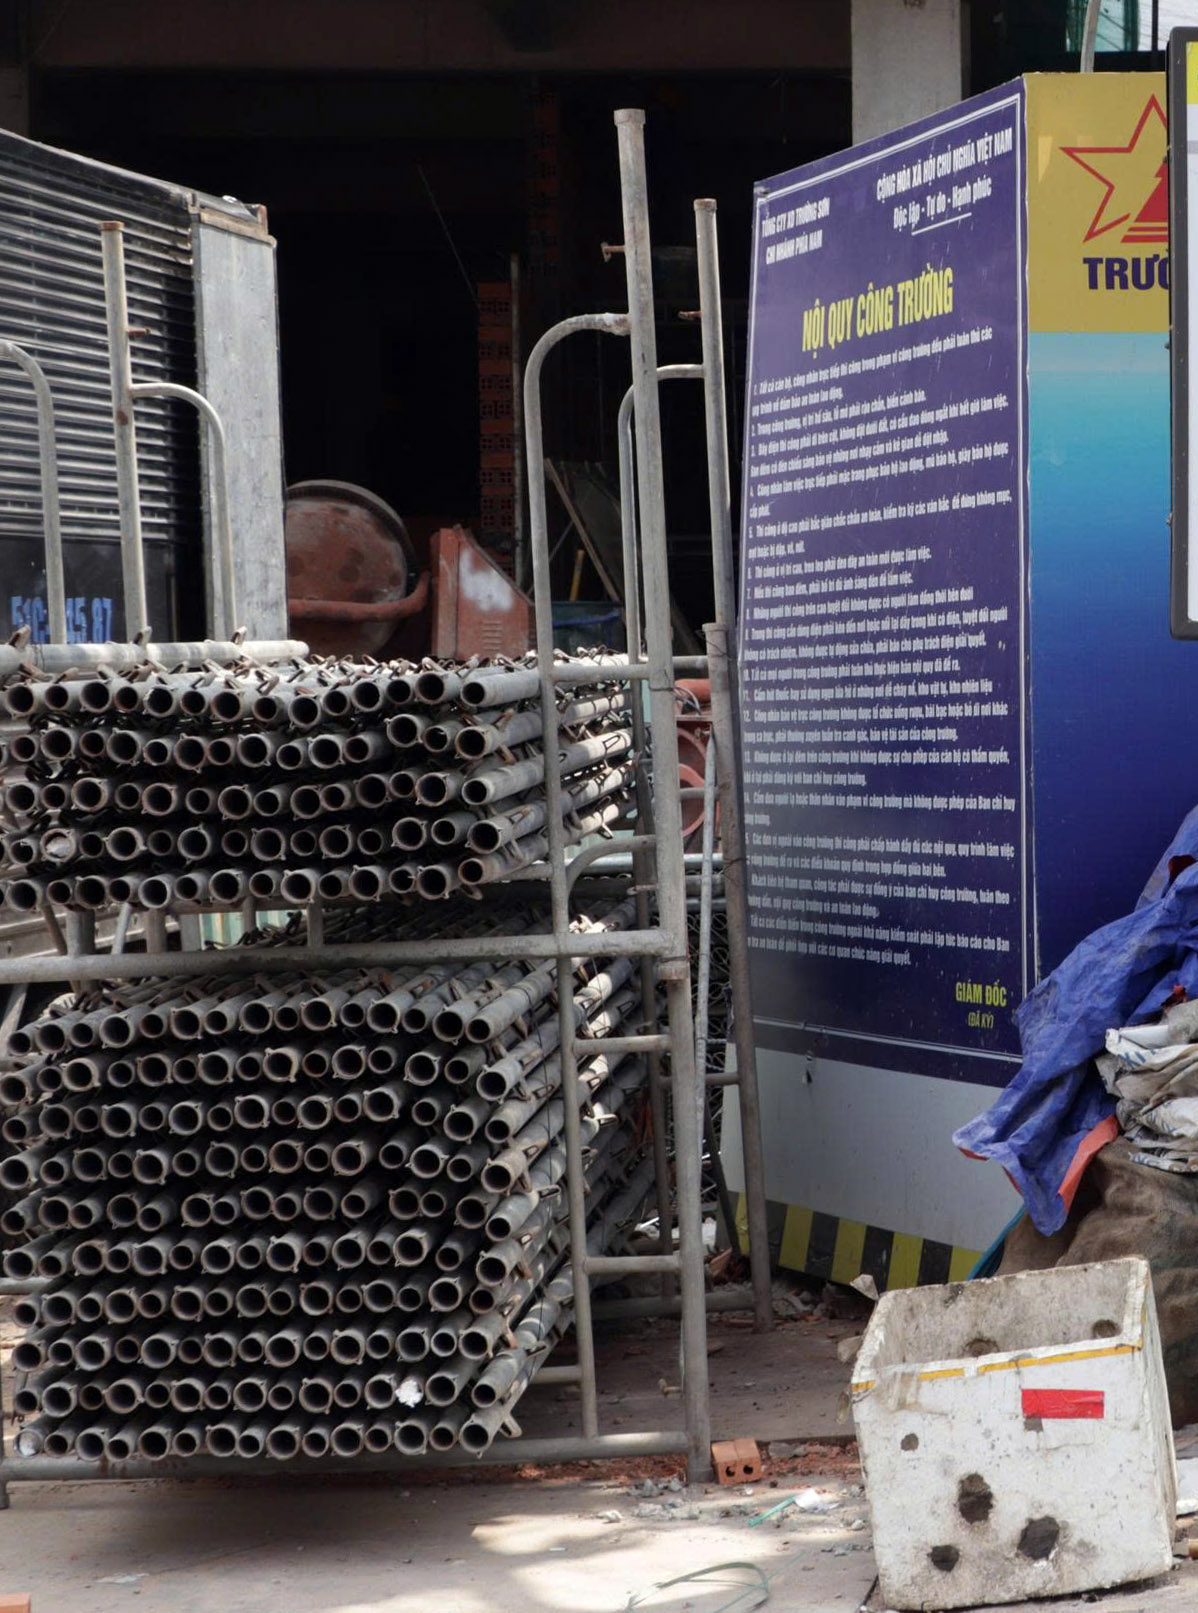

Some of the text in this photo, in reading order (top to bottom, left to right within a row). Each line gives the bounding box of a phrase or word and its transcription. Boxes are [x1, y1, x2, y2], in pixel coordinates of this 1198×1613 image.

[801, 262, 954, 359] NỘI QUY CÔNG TRƯỜNG
[955, 978, 1007, 1007] GIÁM ĐỐC
